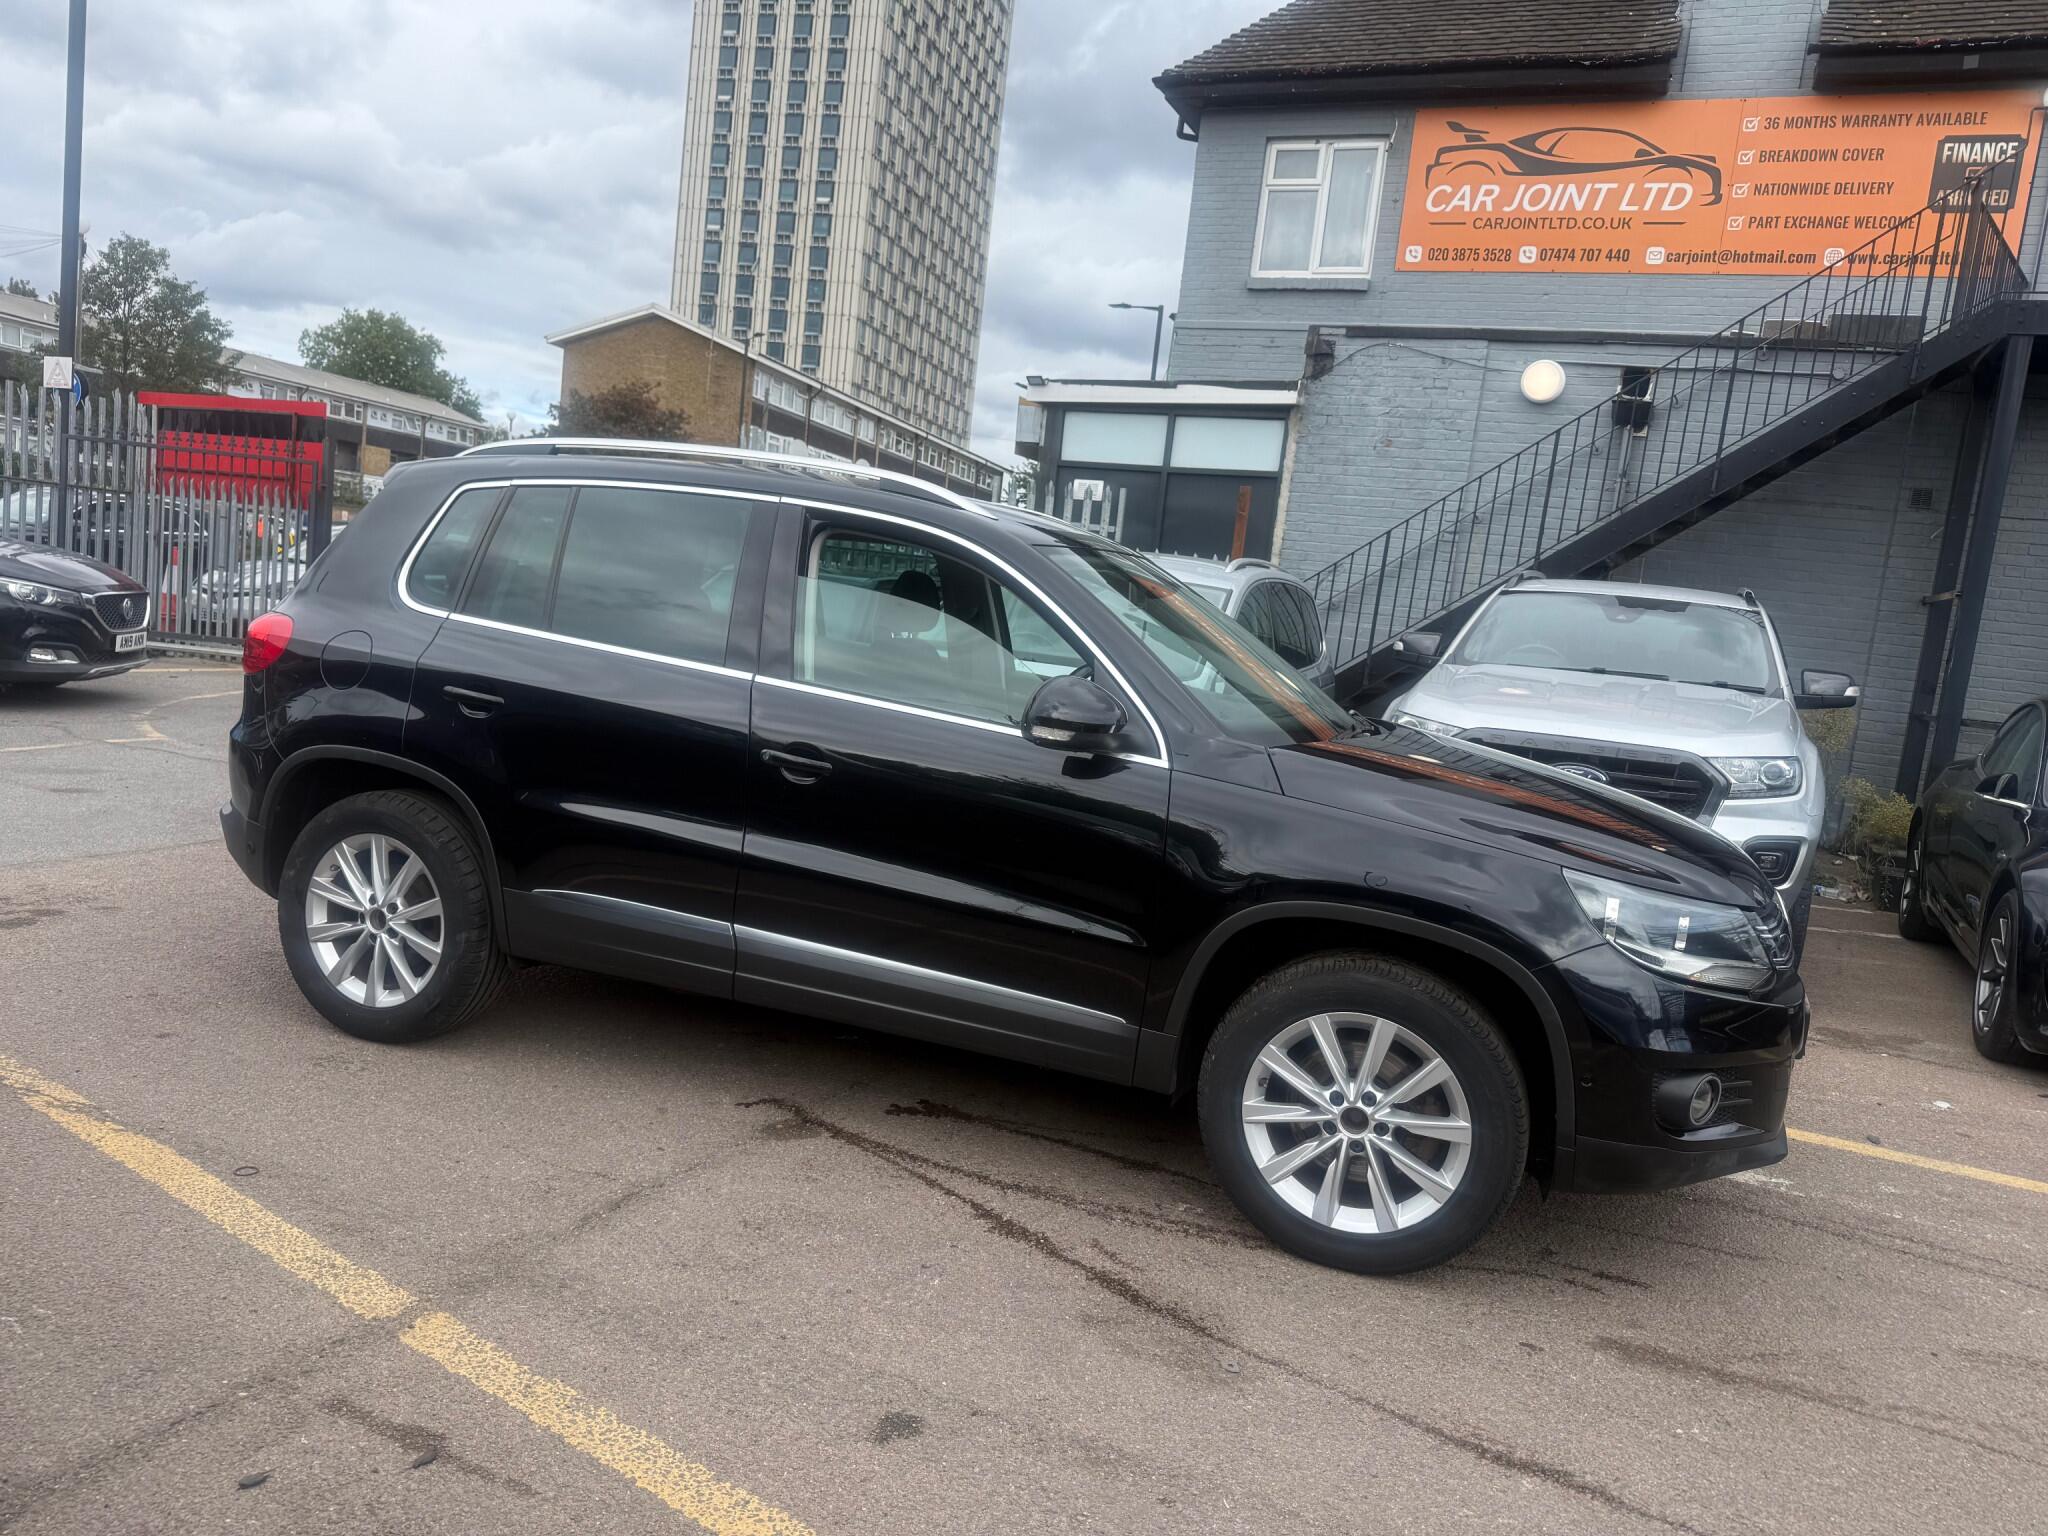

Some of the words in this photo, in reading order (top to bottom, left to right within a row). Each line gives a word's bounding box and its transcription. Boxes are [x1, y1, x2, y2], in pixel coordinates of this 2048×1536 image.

[1764, 117, 1780, 130] 36
[1783, 115, 1837, 129] MONTHS
[1841, 113, 1913, 128] WARRANTY
[1916, 111, 1988, 127] AVAILABLE
[1759, 149, 1838, 163] BREAKDOWN
[1842, 148, 1885, 162] COVER
[1942, 142, 2018, 164] FINANCE
[1753, 182, 1830, 196] NATIONWIDE
[1834, 181, 1894, 195] DELIVERY
[1425, 184, 1500, 212] CAR
[1502, 183, 1616, 212] JOINT
[1619, 182, 1693, 211] LTD
[1472, 217, 1632, 231] CARJOINTLTD.CO.UK
[1748, 216, 1780, 229] PART
[1784, 216, 1849, 229] EXCHANGE
[1854, 215, 1916, 230] WELCOME
[1428, 247, 1449, 262] 020
[1451, 247, 1480, 262] 3875
[1483, 248, 1512, 262] 3528
[1540, 248, 1576, 262] 07474
[1579, 248, 1601, 262] 707
[1605, 248, 1630, 262] 440
[1666, 249, 1817, 265] carjoint@hotmail.com
